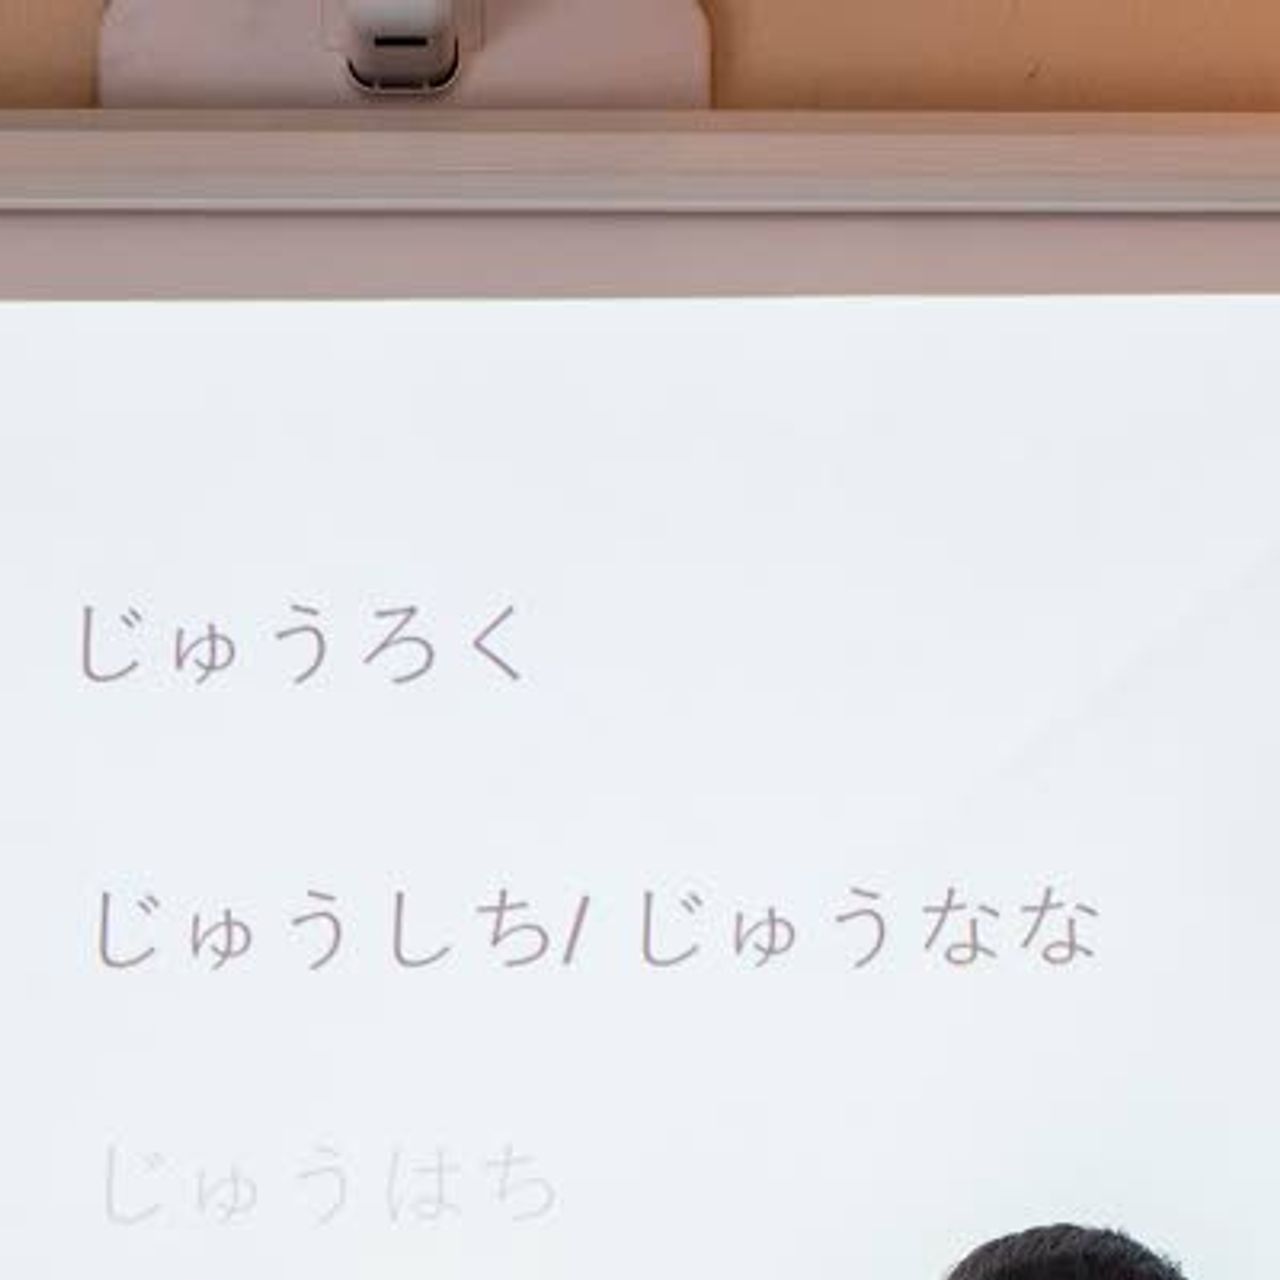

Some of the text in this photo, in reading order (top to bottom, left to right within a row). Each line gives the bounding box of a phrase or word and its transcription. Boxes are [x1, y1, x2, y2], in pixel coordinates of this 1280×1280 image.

[82, 603, 524, 686] じゅうろく
[642, 886, 1101, 972] じゅうなな
[105, 1143, 558, 1228] じゅうはち
